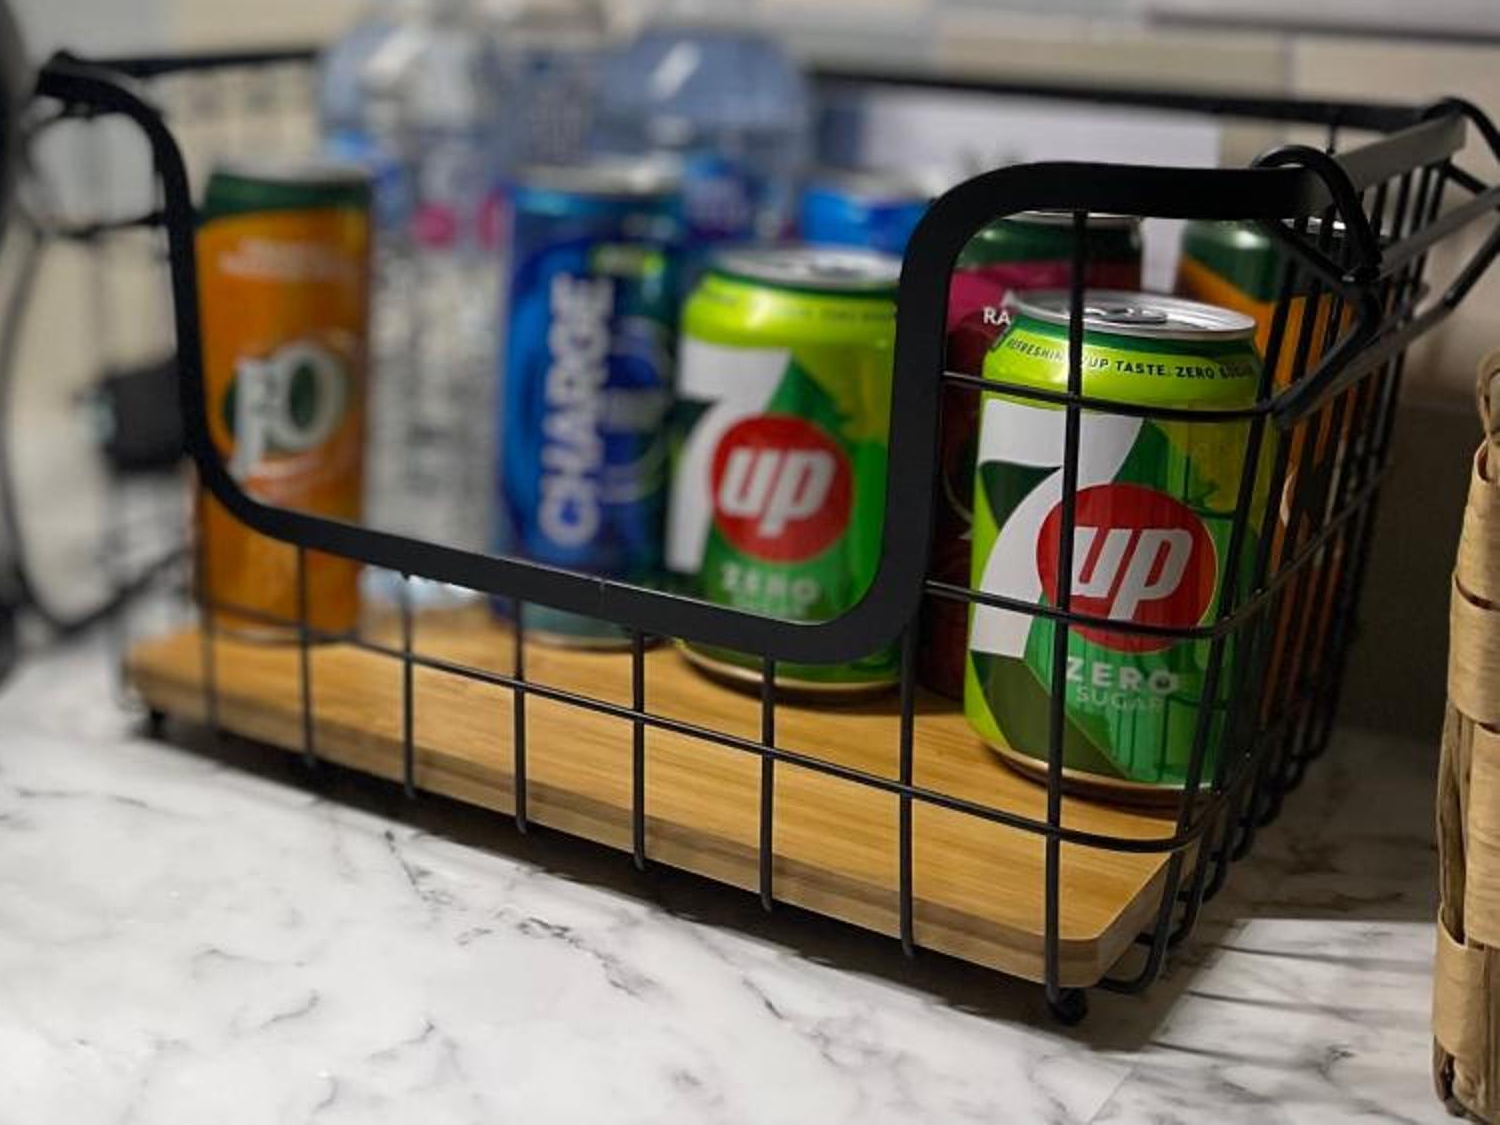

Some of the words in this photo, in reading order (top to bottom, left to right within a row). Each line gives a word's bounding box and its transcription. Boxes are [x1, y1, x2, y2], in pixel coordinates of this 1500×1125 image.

[1008, 337, 1070, 364] REFRESHIN
[1175, 365, 1215, 379] ZERO
[538, 272, 614, 547] CHARGE
[719, 559, 821, 605] ZERO
[1065, 655, 1181, 696] ZERO
